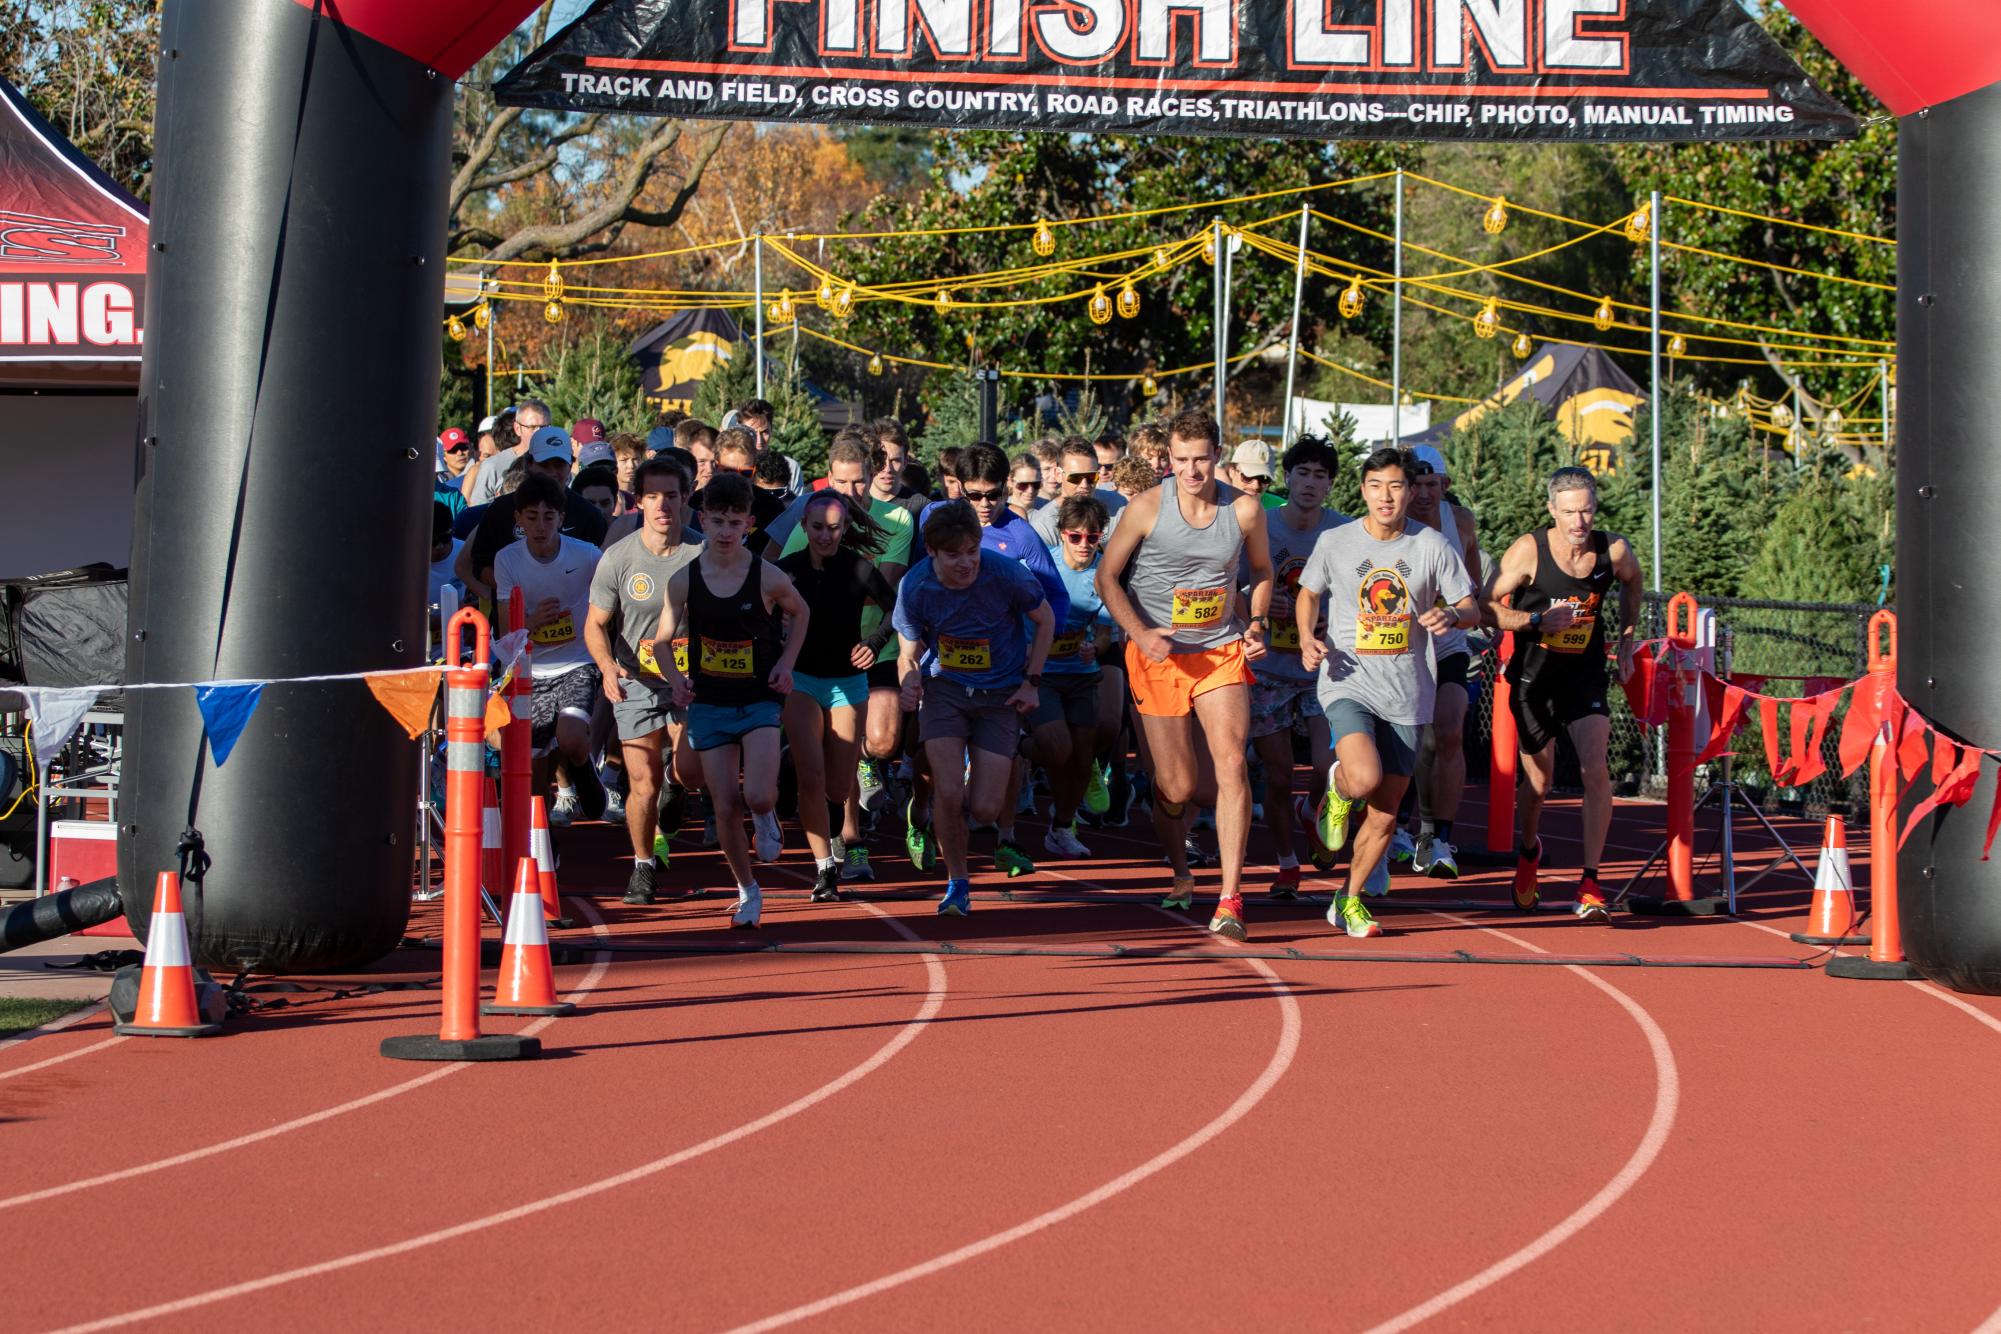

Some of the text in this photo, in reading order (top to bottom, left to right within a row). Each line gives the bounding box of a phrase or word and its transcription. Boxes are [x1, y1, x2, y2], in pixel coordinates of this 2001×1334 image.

[561, 73, 651, 97] TRACK
[657, 79, 714, 100] AND
[721, 82, 803, 107] FIELD,
[811, 85, 900, 107] CROSS
[907, 89, 1039, 116] COUNTRY,
[1047, 93, 1119, 115] ROAD
[1481, 104, 1576, 128] PHOTO,
[1584, 104, 1694, 124] MANUAL
[1699, 105, 1795, 123] TIMING
[1194, 606, 1218, 619] 582
[542, 625, 573, 639] 1249
[1379, 632, 1404, 645] 750
[1562, 633, 1586, 645] 599
[721, 658, 747, 669] 125
[959, 654, 984, 665] 262
